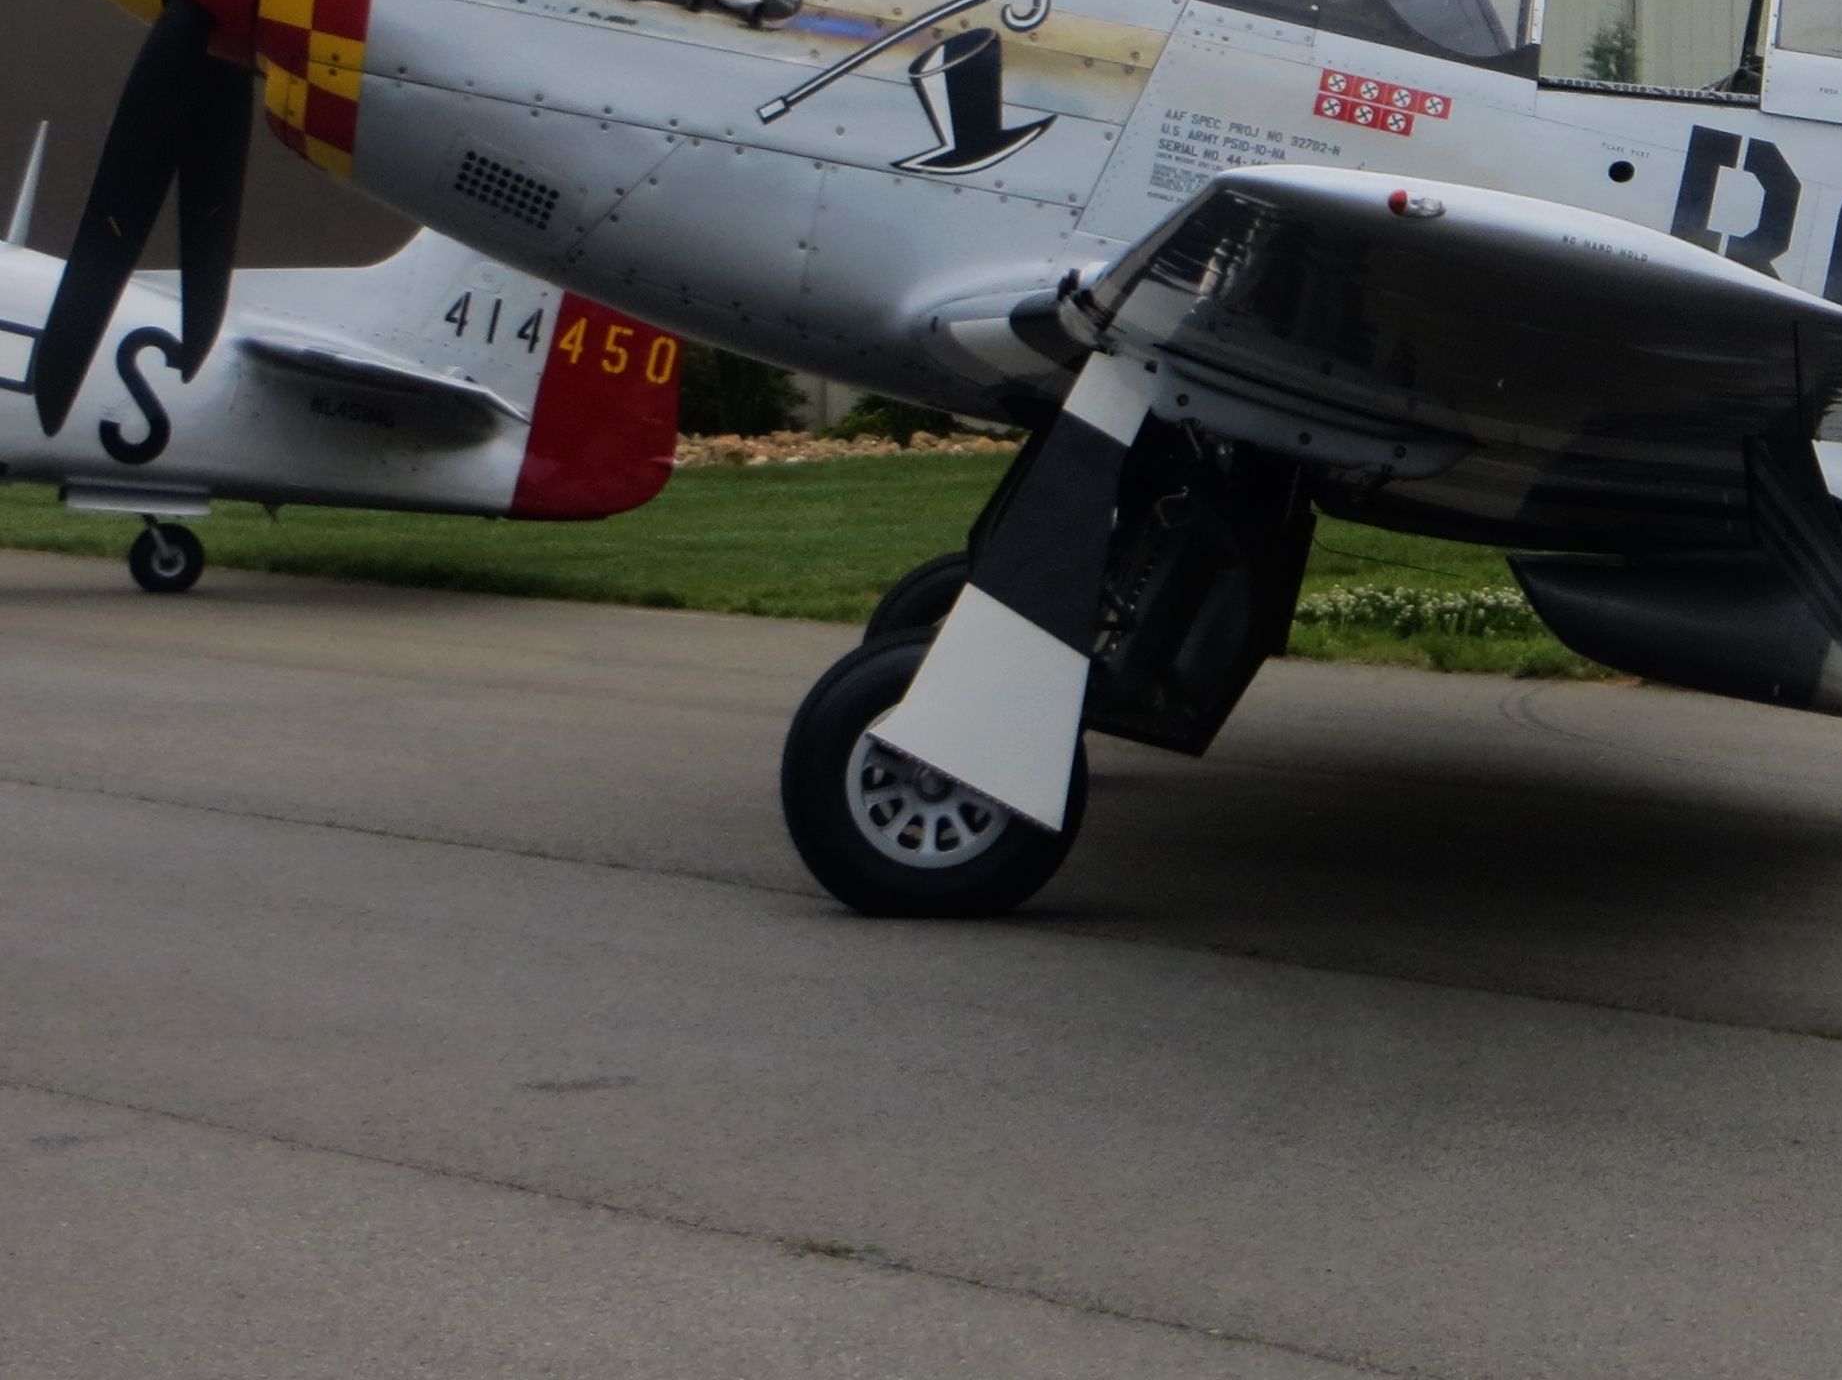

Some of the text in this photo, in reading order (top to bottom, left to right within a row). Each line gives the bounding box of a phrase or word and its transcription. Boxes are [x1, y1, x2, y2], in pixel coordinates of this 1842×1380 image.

[1187, 128, 1220, 146] ARMY
[1158, 138, 1198, 157] SERIAL
[98, 326, 185, 465] S
